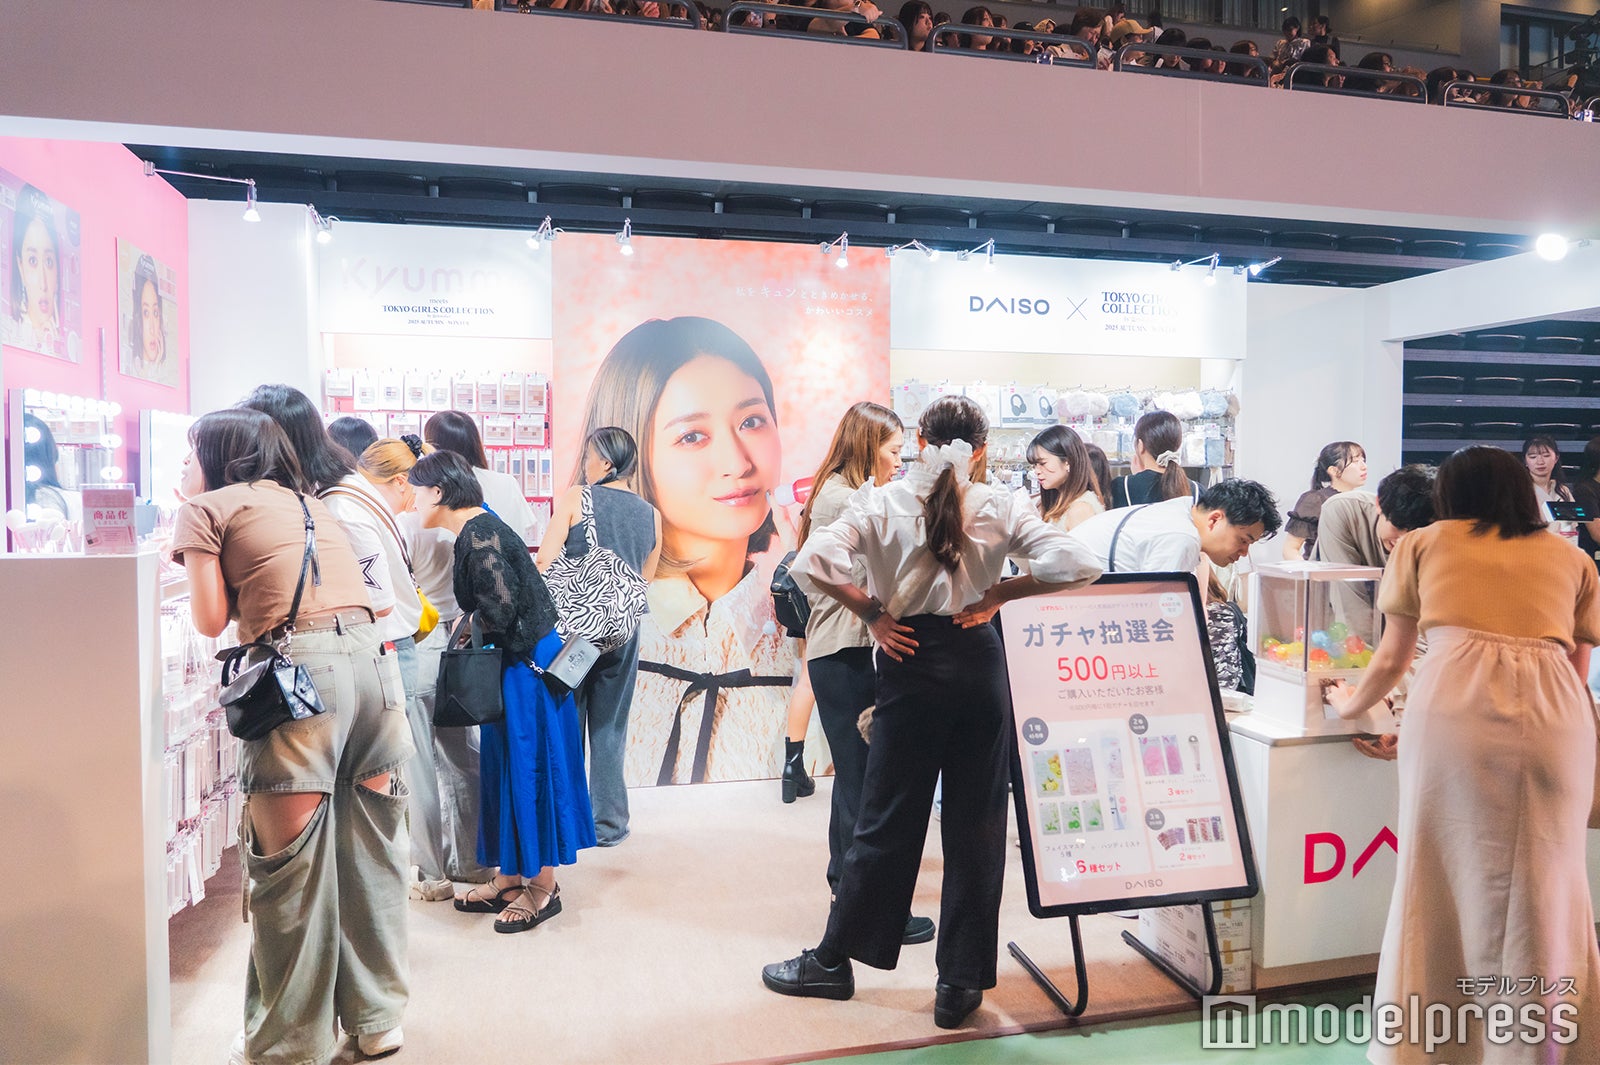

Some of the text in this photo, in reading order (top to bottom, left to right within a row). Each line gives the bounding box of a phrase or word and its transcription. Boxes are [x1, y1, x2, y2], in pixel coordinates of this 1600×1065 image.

[1101, 291, 1140, 304] TOKYO
[382, 304, 495, 315] TOKYO GIRLS COLLECTION
[805, 306, 873, 317] かわいいコスメ
[969, 295, 1050, 315] DAISO
[93, 510, 128, 520] 商品化
[1022, 618, 1175, 648] ガチャ抽選会
[1057, 655, 1159, 682] 500円以上
[1057, 684, 1165, 700] ご購入いただいたお客様
[1125, 878, 1164, 890] DAISO
